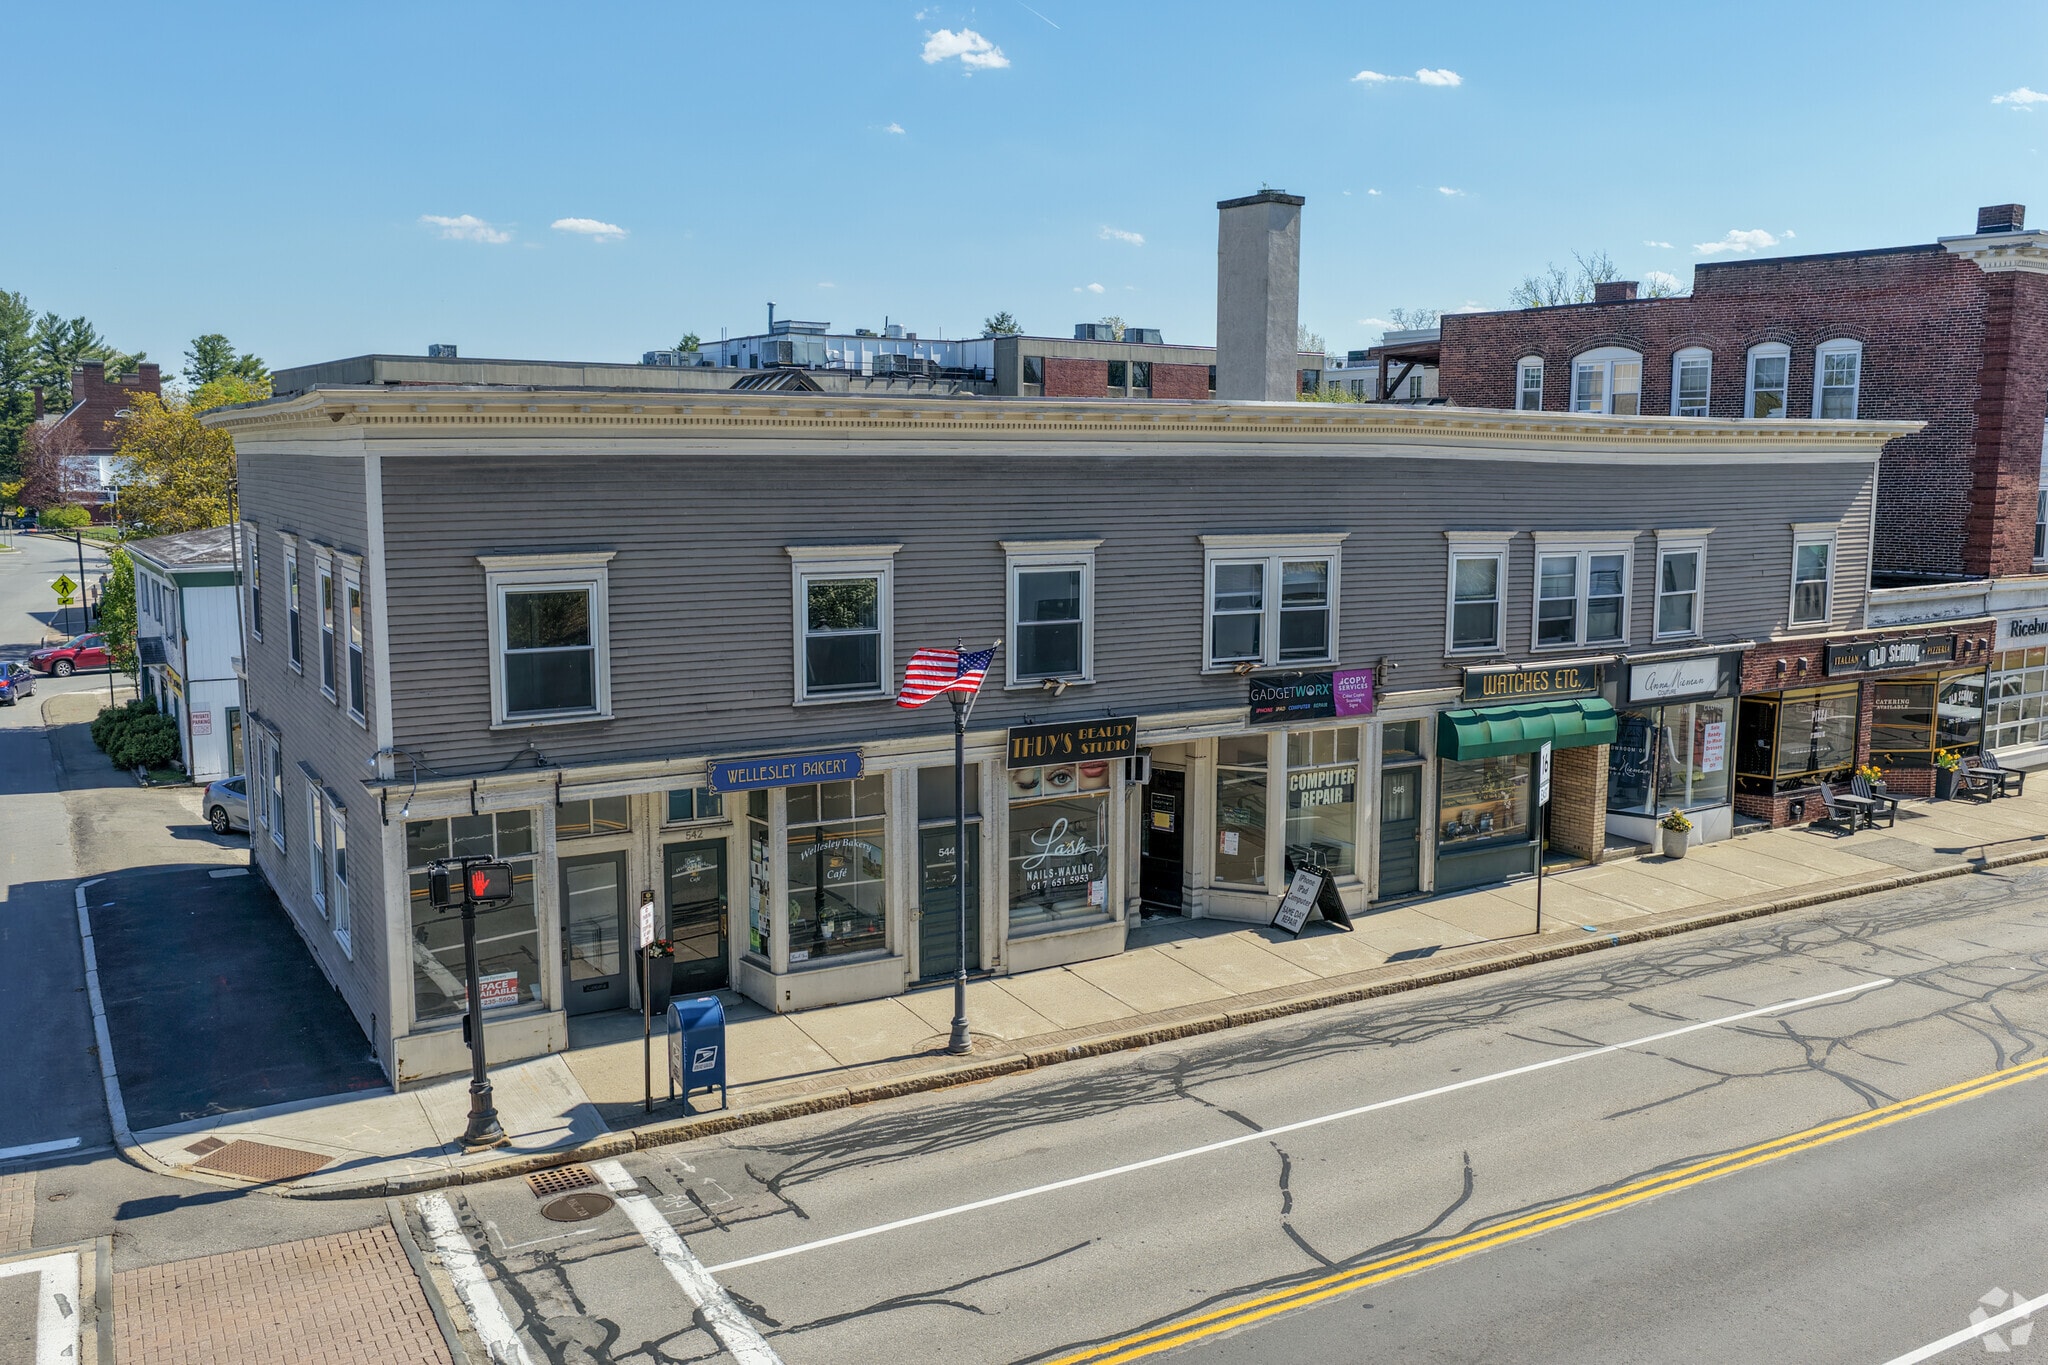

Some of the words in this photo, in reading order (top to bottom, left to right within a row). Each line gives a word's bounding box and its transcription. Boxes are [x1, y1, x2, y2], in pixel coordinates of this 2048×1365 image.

[1834, 655, 1859, 666] ITALIAN
[1868, 646, 1887, 668] OLD
[1888, 643, 1920, 663] SCHOOL
[1927, 645, 1951, 655] PIZZERIA
[1338, 683, 1368, 691] SERVICES
[1483, 670, 1549, 696] WATCHES
[1555, 668, 1581, 689] ETC.
[1250, 683, 1330, 701] GADGETWORX
[1011, 732, 1073, 759] THUY'S
[1078, 724, 1134, 740] BEAUTY
[1080, 739, 1131, 755] STUDIO
[727, 763, 797, 784] WELLESLEY
[803, 758, 848, 776] BAKERY
[1542, 753, 1549, 775] 16
[1289, 768, 1356, 792] COMPUTER
[1301, 787, 1344, 808] REPAIR
[685, 829, 704, 840] 542
[1021, 817, 1090, 870] Lash
[800, 840, 841, 861] Wellesley
[843, 838, 872, 853] Bakery
[938, 846, 955, 857] 544
[827, 867, 848, 881] Café
[1031, 880, 1048, 891] 617
[1051, 877, 1066, 887] 651
[1069, 874, 1089, 885] 5953
[480, 980, 509, 991] PACE
[480, 986, 517, 997] AILABLE
[481, 996, 516, 1006] -235-5600
